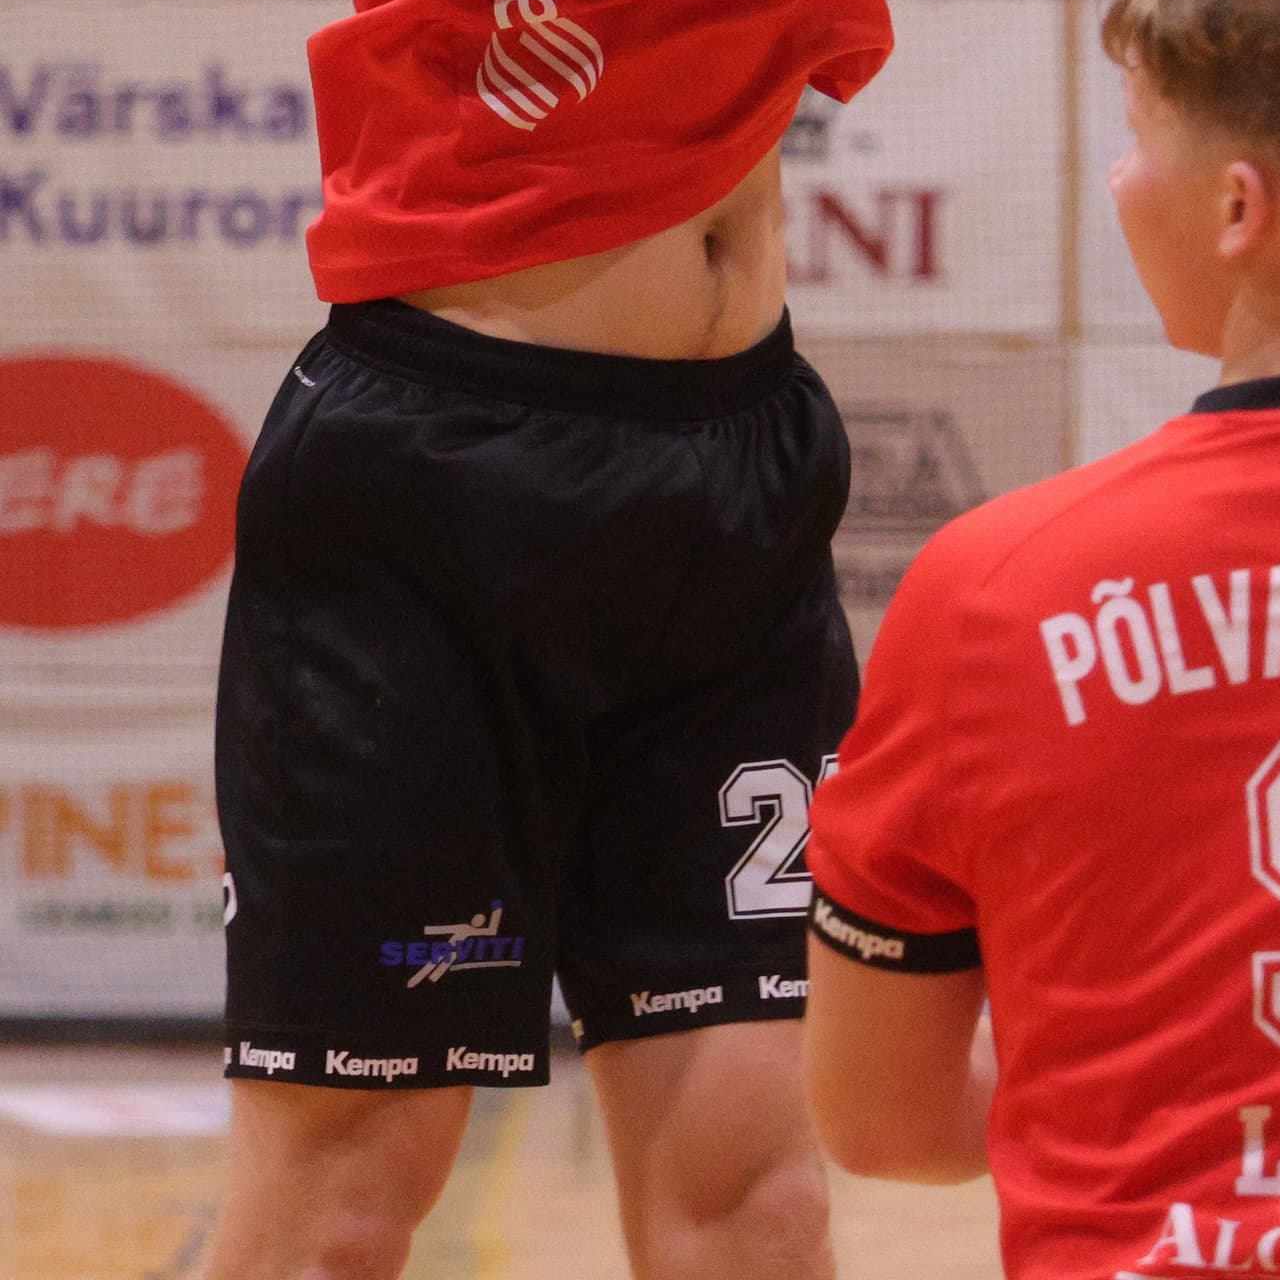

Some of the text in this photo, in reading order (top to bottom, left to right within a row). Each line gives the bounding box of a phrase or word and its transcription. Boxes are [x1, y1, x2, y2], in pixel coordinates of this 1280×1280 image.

[815, 896, 906, 961] Kempa
[378, 936, 526, 968] SERVITI
[630, 983, 724, 1017] Kempa
[239, 1040, 535, 1083] Kempa Kempa Kempa
